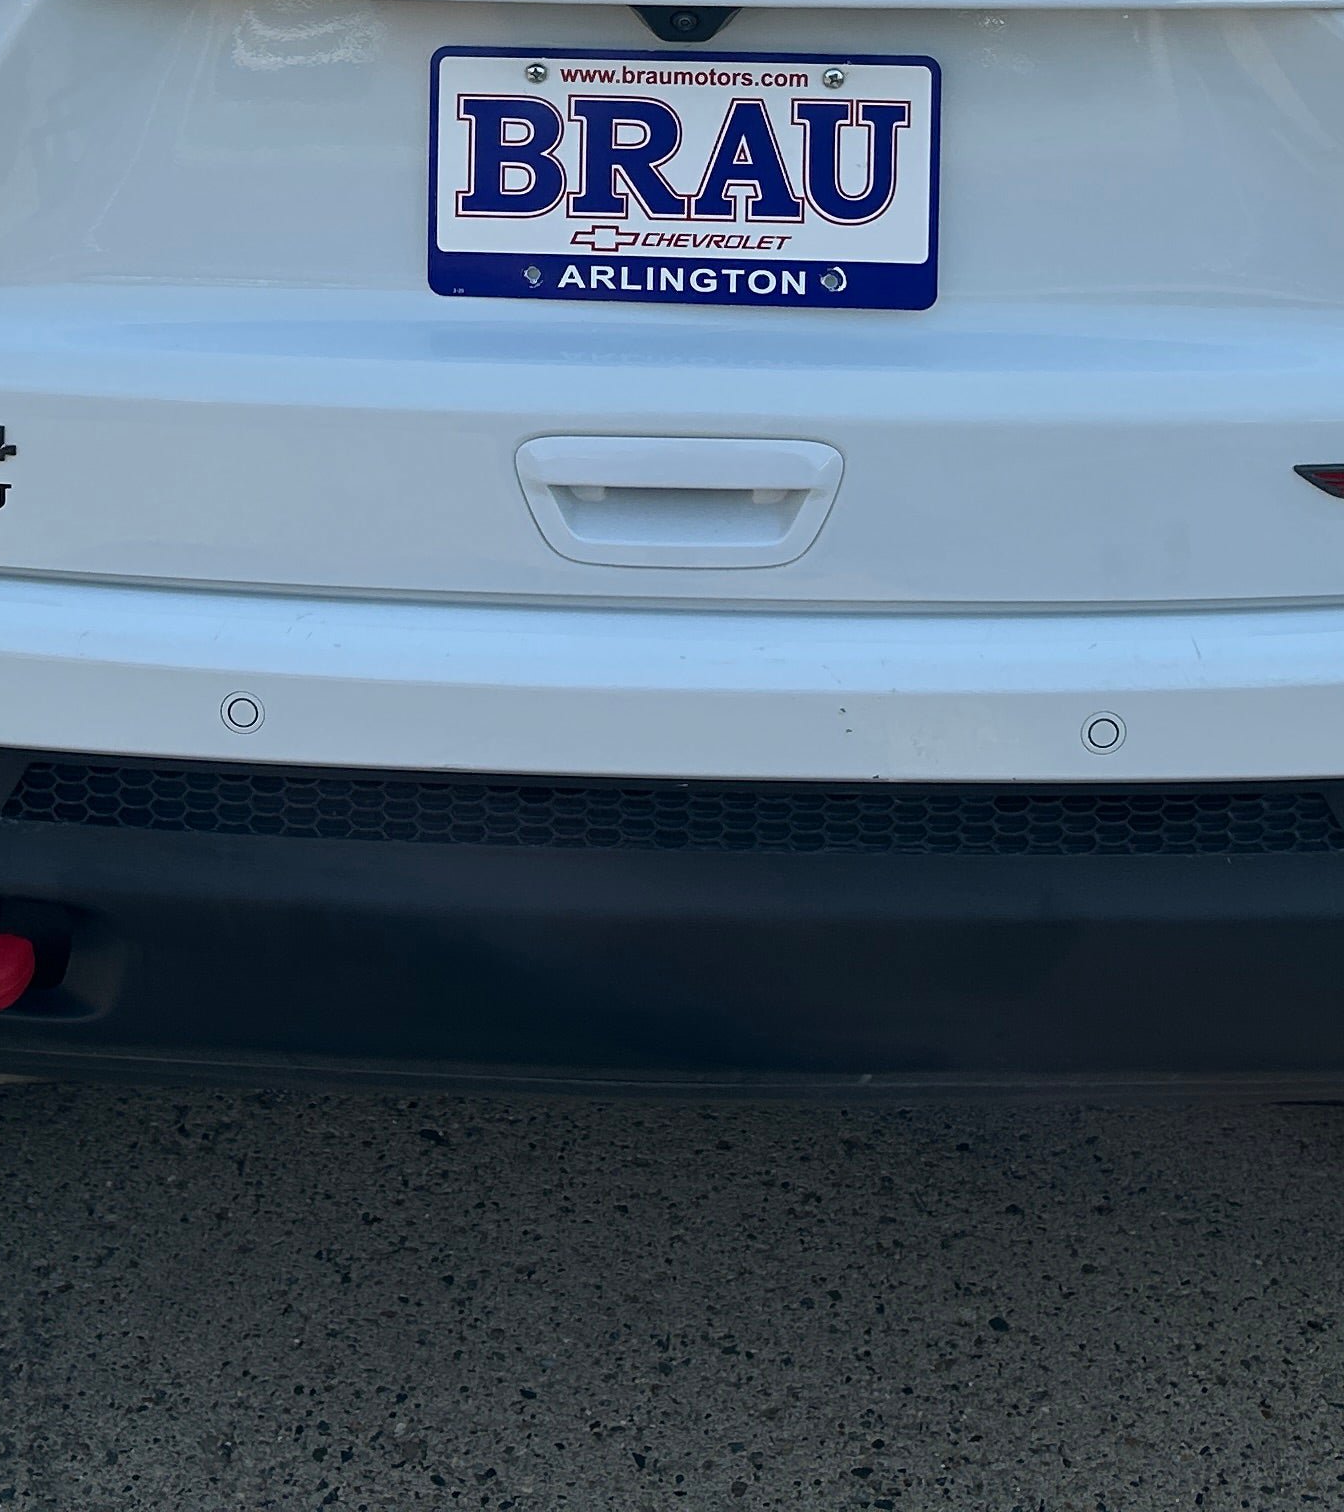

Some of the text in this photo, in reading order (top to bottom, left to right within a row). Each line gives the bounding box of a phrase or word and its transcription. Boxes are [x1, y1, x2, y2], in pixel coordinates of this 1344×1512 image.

[560, 66, 809, 88] www.braumotors.com
[455, 94, 911, 226] BRAU
[641, 232, 793, 251] CHEVROLET
[557, 264, 807, 295] ARLINGTON
